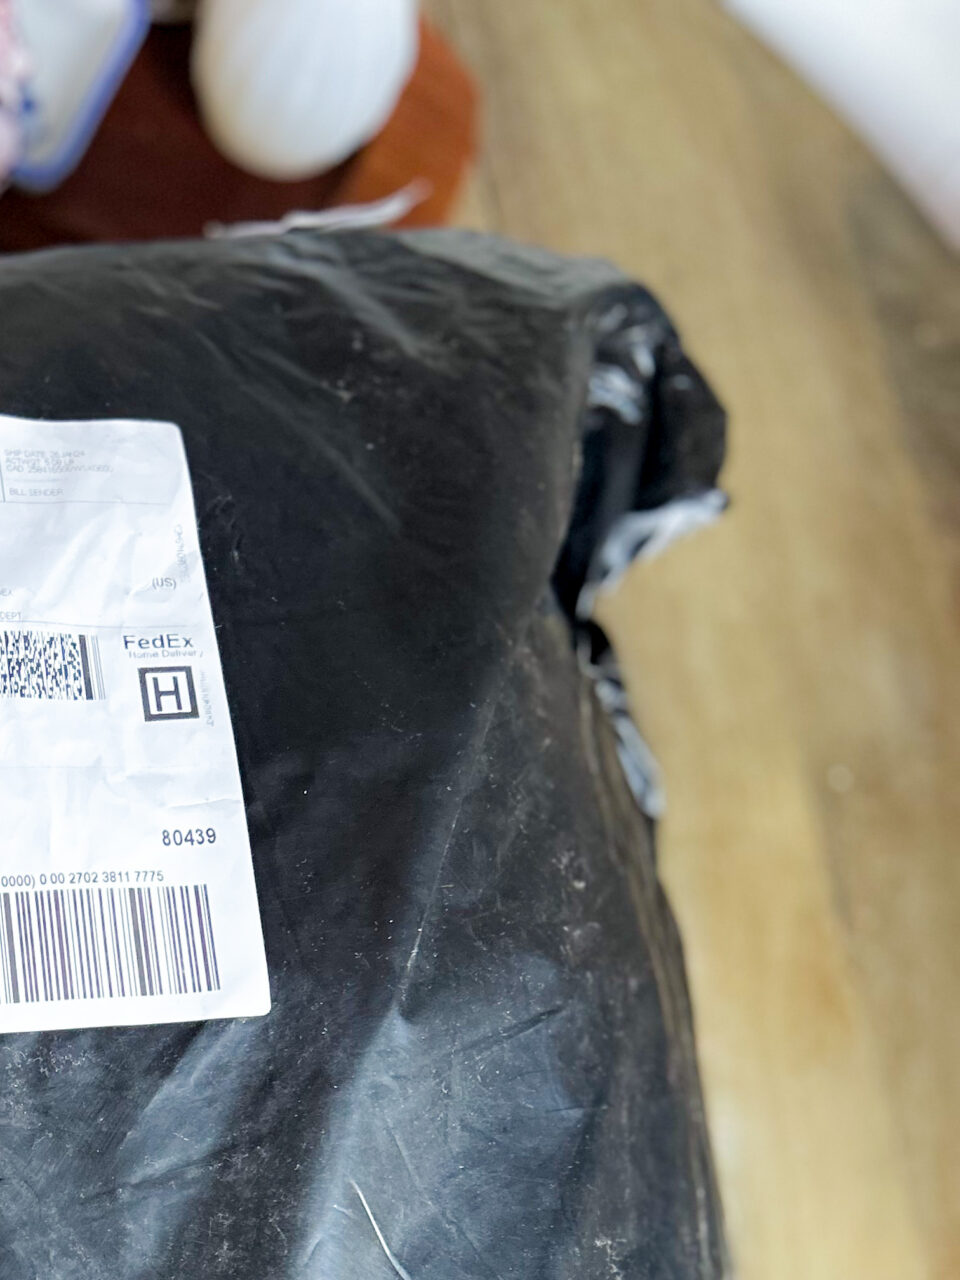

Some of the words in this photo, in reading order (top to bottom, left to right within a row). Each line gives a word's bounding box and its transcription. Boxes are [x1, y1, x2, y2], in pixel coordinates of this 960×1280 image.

[152, 577, 177, 590] (US)
[122, 633, 194, 650] FedEx
[152, 676, 182, 712] H
[161, 827, 217, 847] 80439
[1, 874, 36, 889] 0000)
[40, 873, 47, 885] 0
[50, 872, 65, 885] 00
[68, 871, 99, 884] 2702
[102, 870, 130, 883] 3811
[134, 870, 164, 883] 7775
